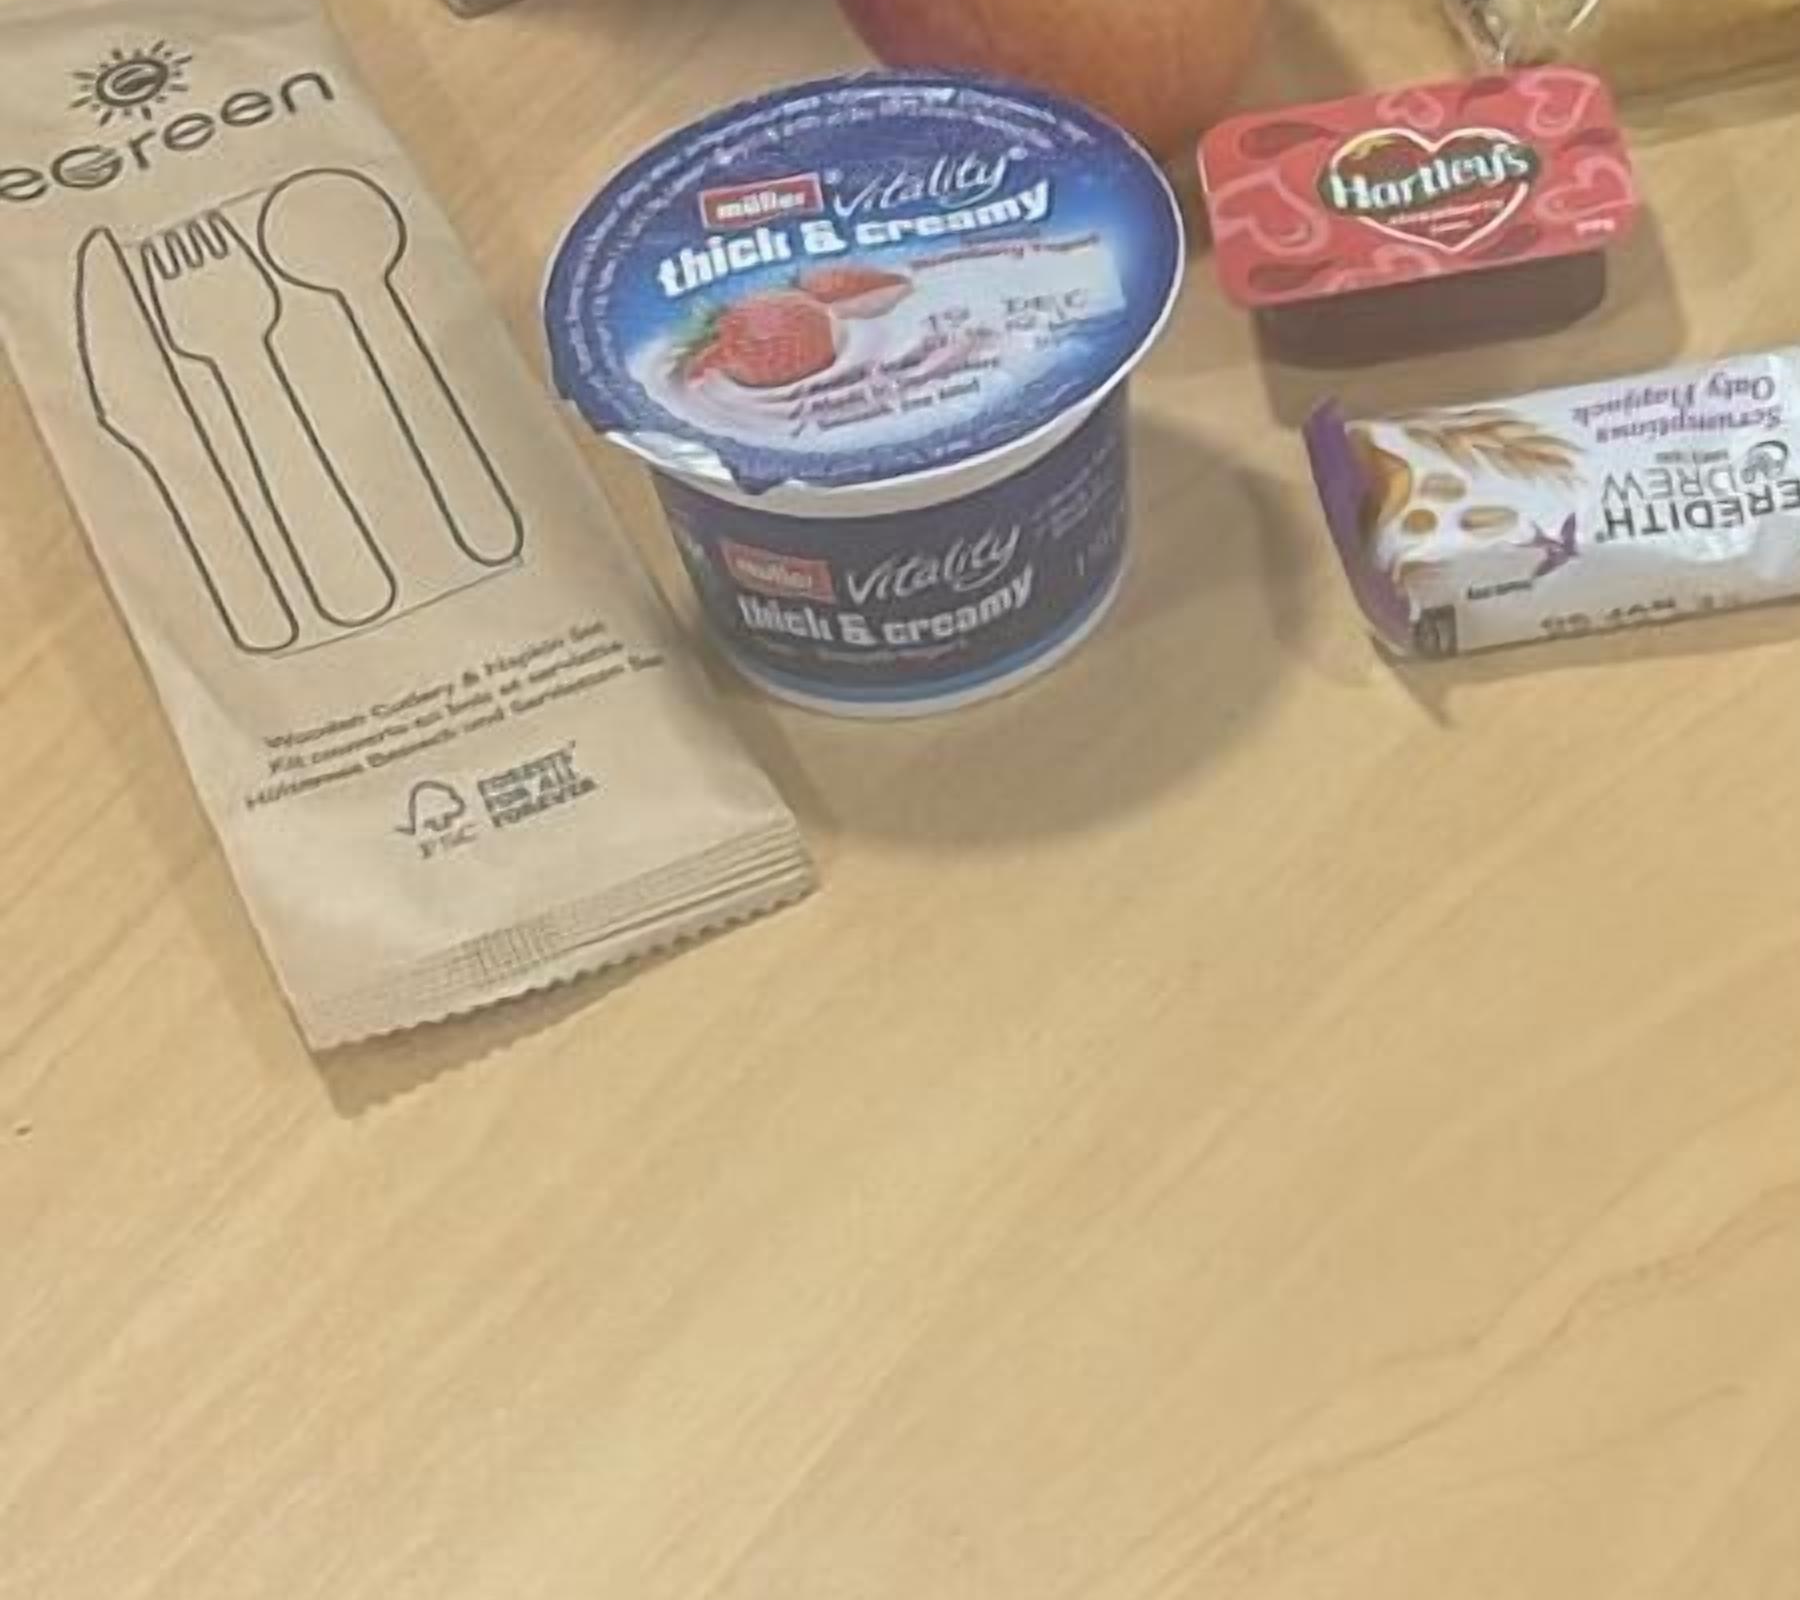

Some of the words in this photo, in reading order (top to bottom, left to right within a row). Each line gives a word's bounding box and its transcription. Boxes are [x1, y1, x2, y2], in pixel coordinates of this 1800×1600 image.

[0, 71, 336, 201] eGreen
[833, 150, 1009, 217] Vitality
[656, 227, 793, 299] thick
[799, 219, 848, 255] &
[855, 179, 1051, 246] creamy
[1601, 463, 1738, 501] DREW
[736, 593, 835, 642] thick
[837, 612, 879, 647] &
[884, 562, 1036, 646] creamy
[845, 524, 1021, 606] Vitality
